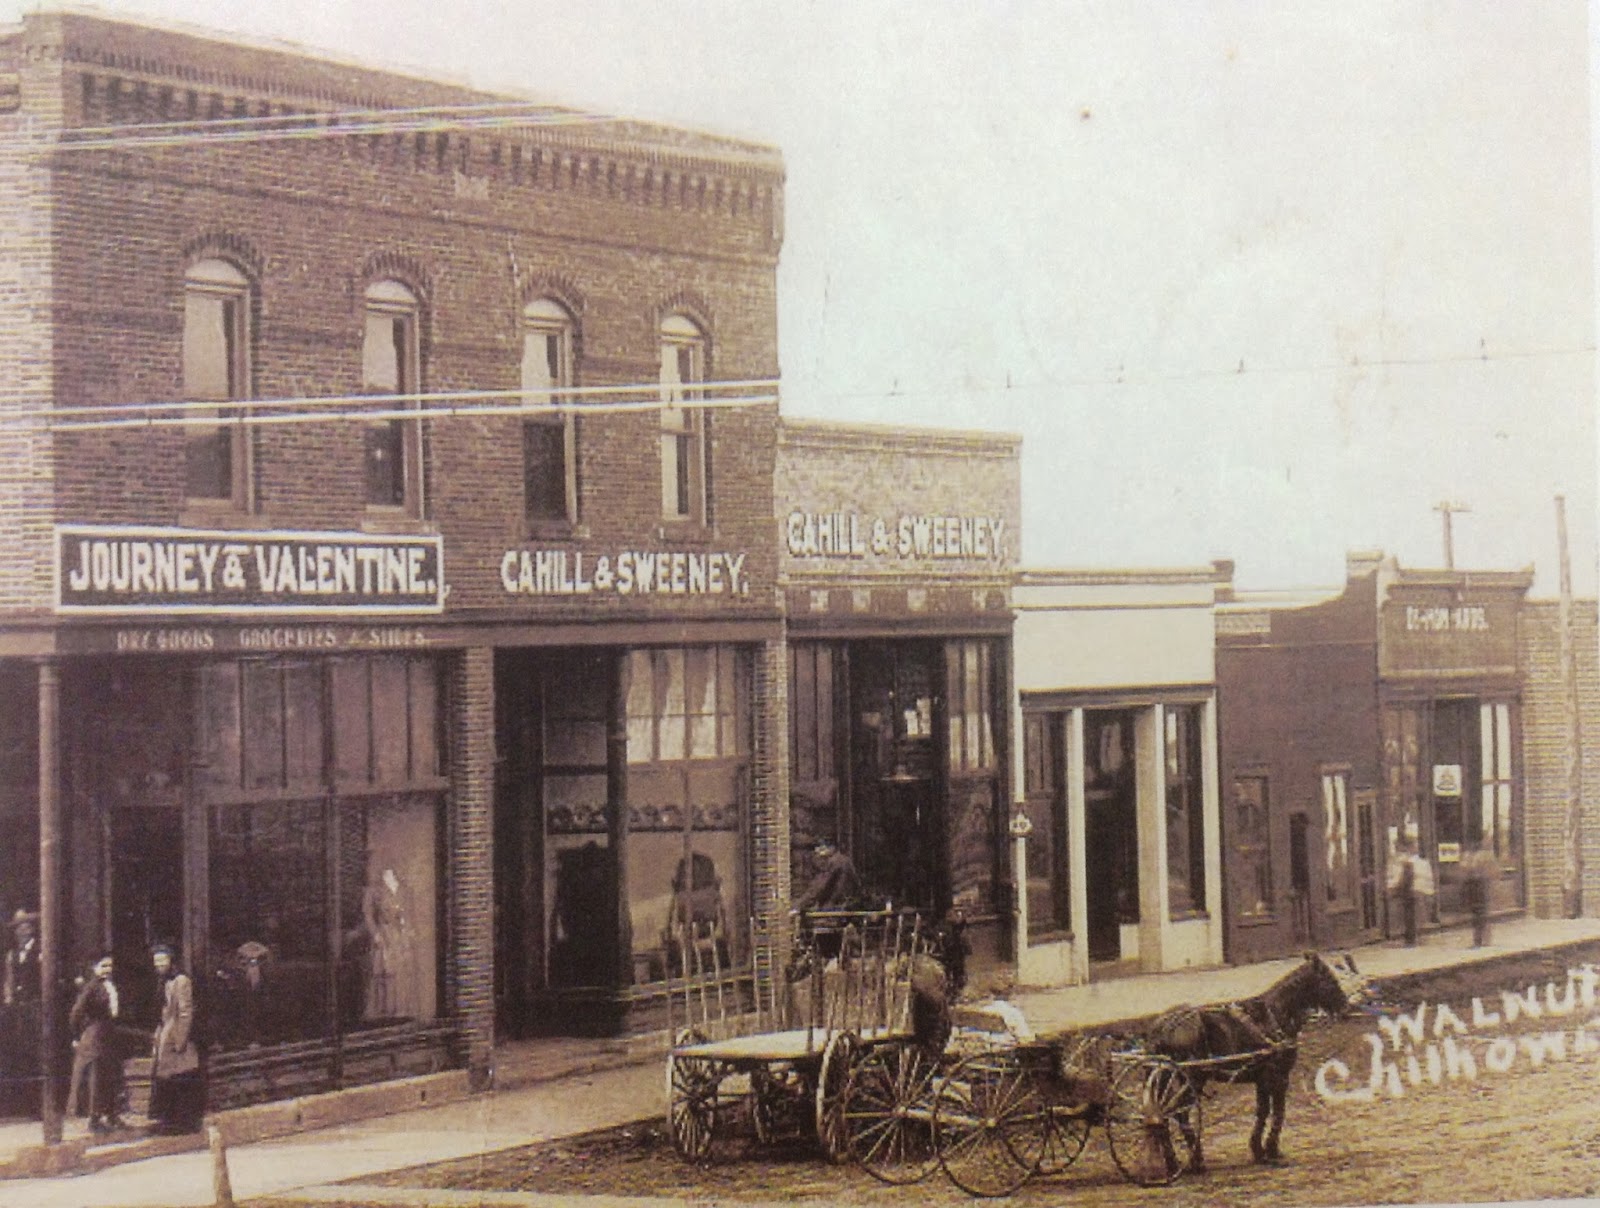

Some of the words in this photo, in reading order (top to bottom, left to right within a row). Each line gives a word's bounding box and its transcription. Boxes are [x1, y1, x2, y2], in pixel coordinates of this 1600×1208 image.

[787, 512, 865, 555] CAHILL
[873, 518, 892, 554] &
[69, 539, 221, 592] JOURNEY
[221, 544, 250, 590] &
[500, 550, 593, 594] CAHILL
[594, 555, 615, 590] &
